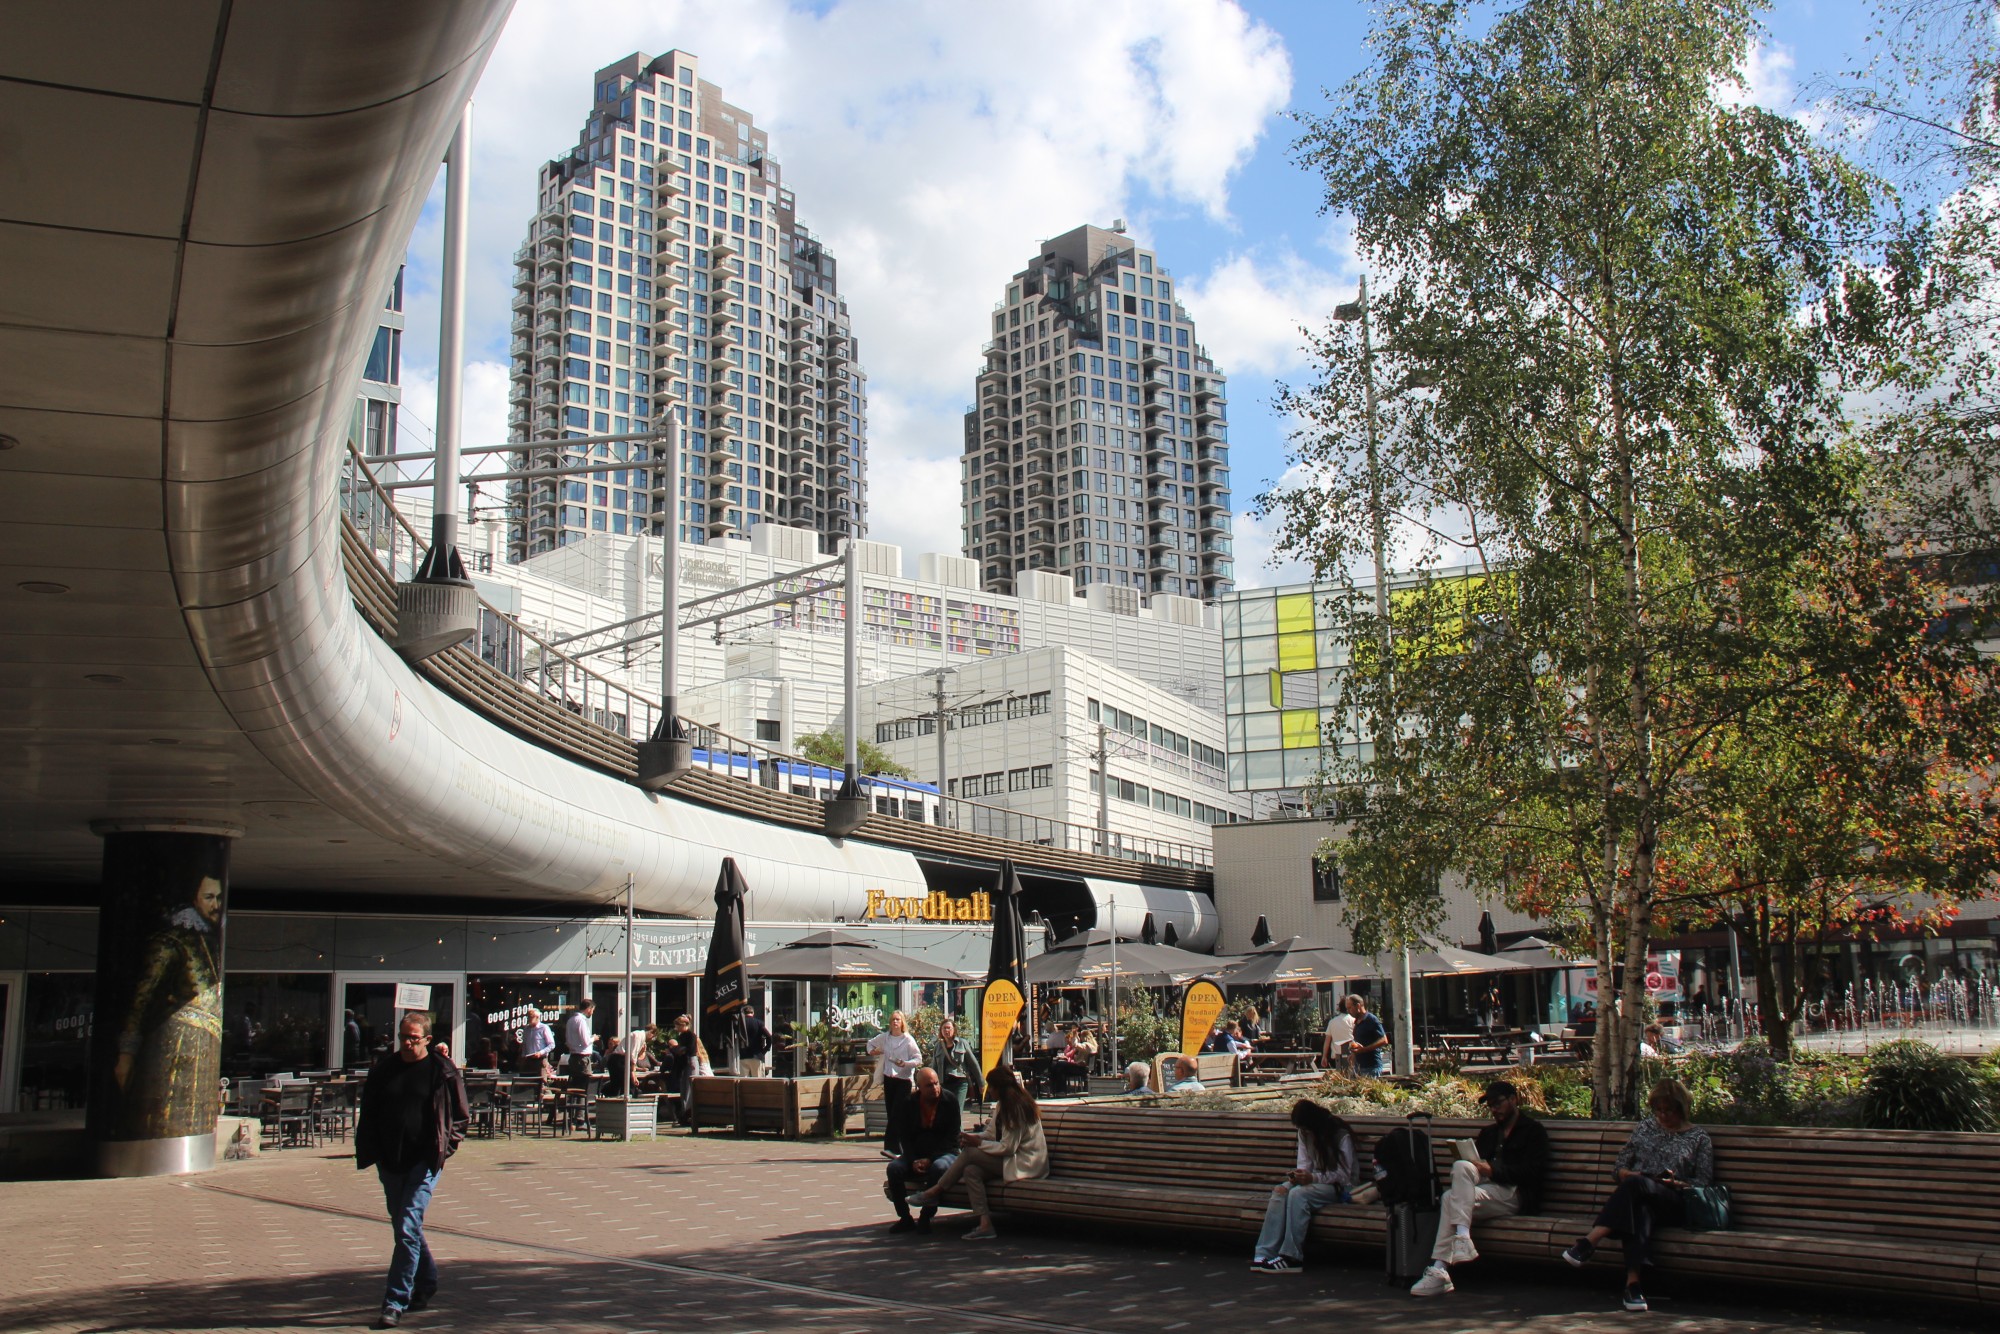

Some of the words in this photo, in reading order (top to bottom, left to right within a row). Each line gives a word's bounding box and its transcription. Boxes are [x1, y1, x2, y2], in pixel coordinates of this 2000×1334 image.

[865, 889, 991, 921] Foodhall
[633, 932, 649, 942] JUST
[650, 935, 658, 943] IN
[659, 934, 676, 944] CASE
[745, 931, 757, 941] THE
[648, 946, 708, 966] ENTRA
[988, 992, 1016, 1002] OPEN
[1190, 993, 1218, 1002] OPEN
[487, 1009, 510, 1024] GOOD
[829, 1004, 874, 1022] MINGLE
[852, 1010, 882, 1028] MUSH
[985, 1010, 1017, 1018] Foodhall
[55, 1014, 85, 1031] GOOD
[503, 1021, 510, 1031] &
[511, 1015, 528, 1029] GOO
